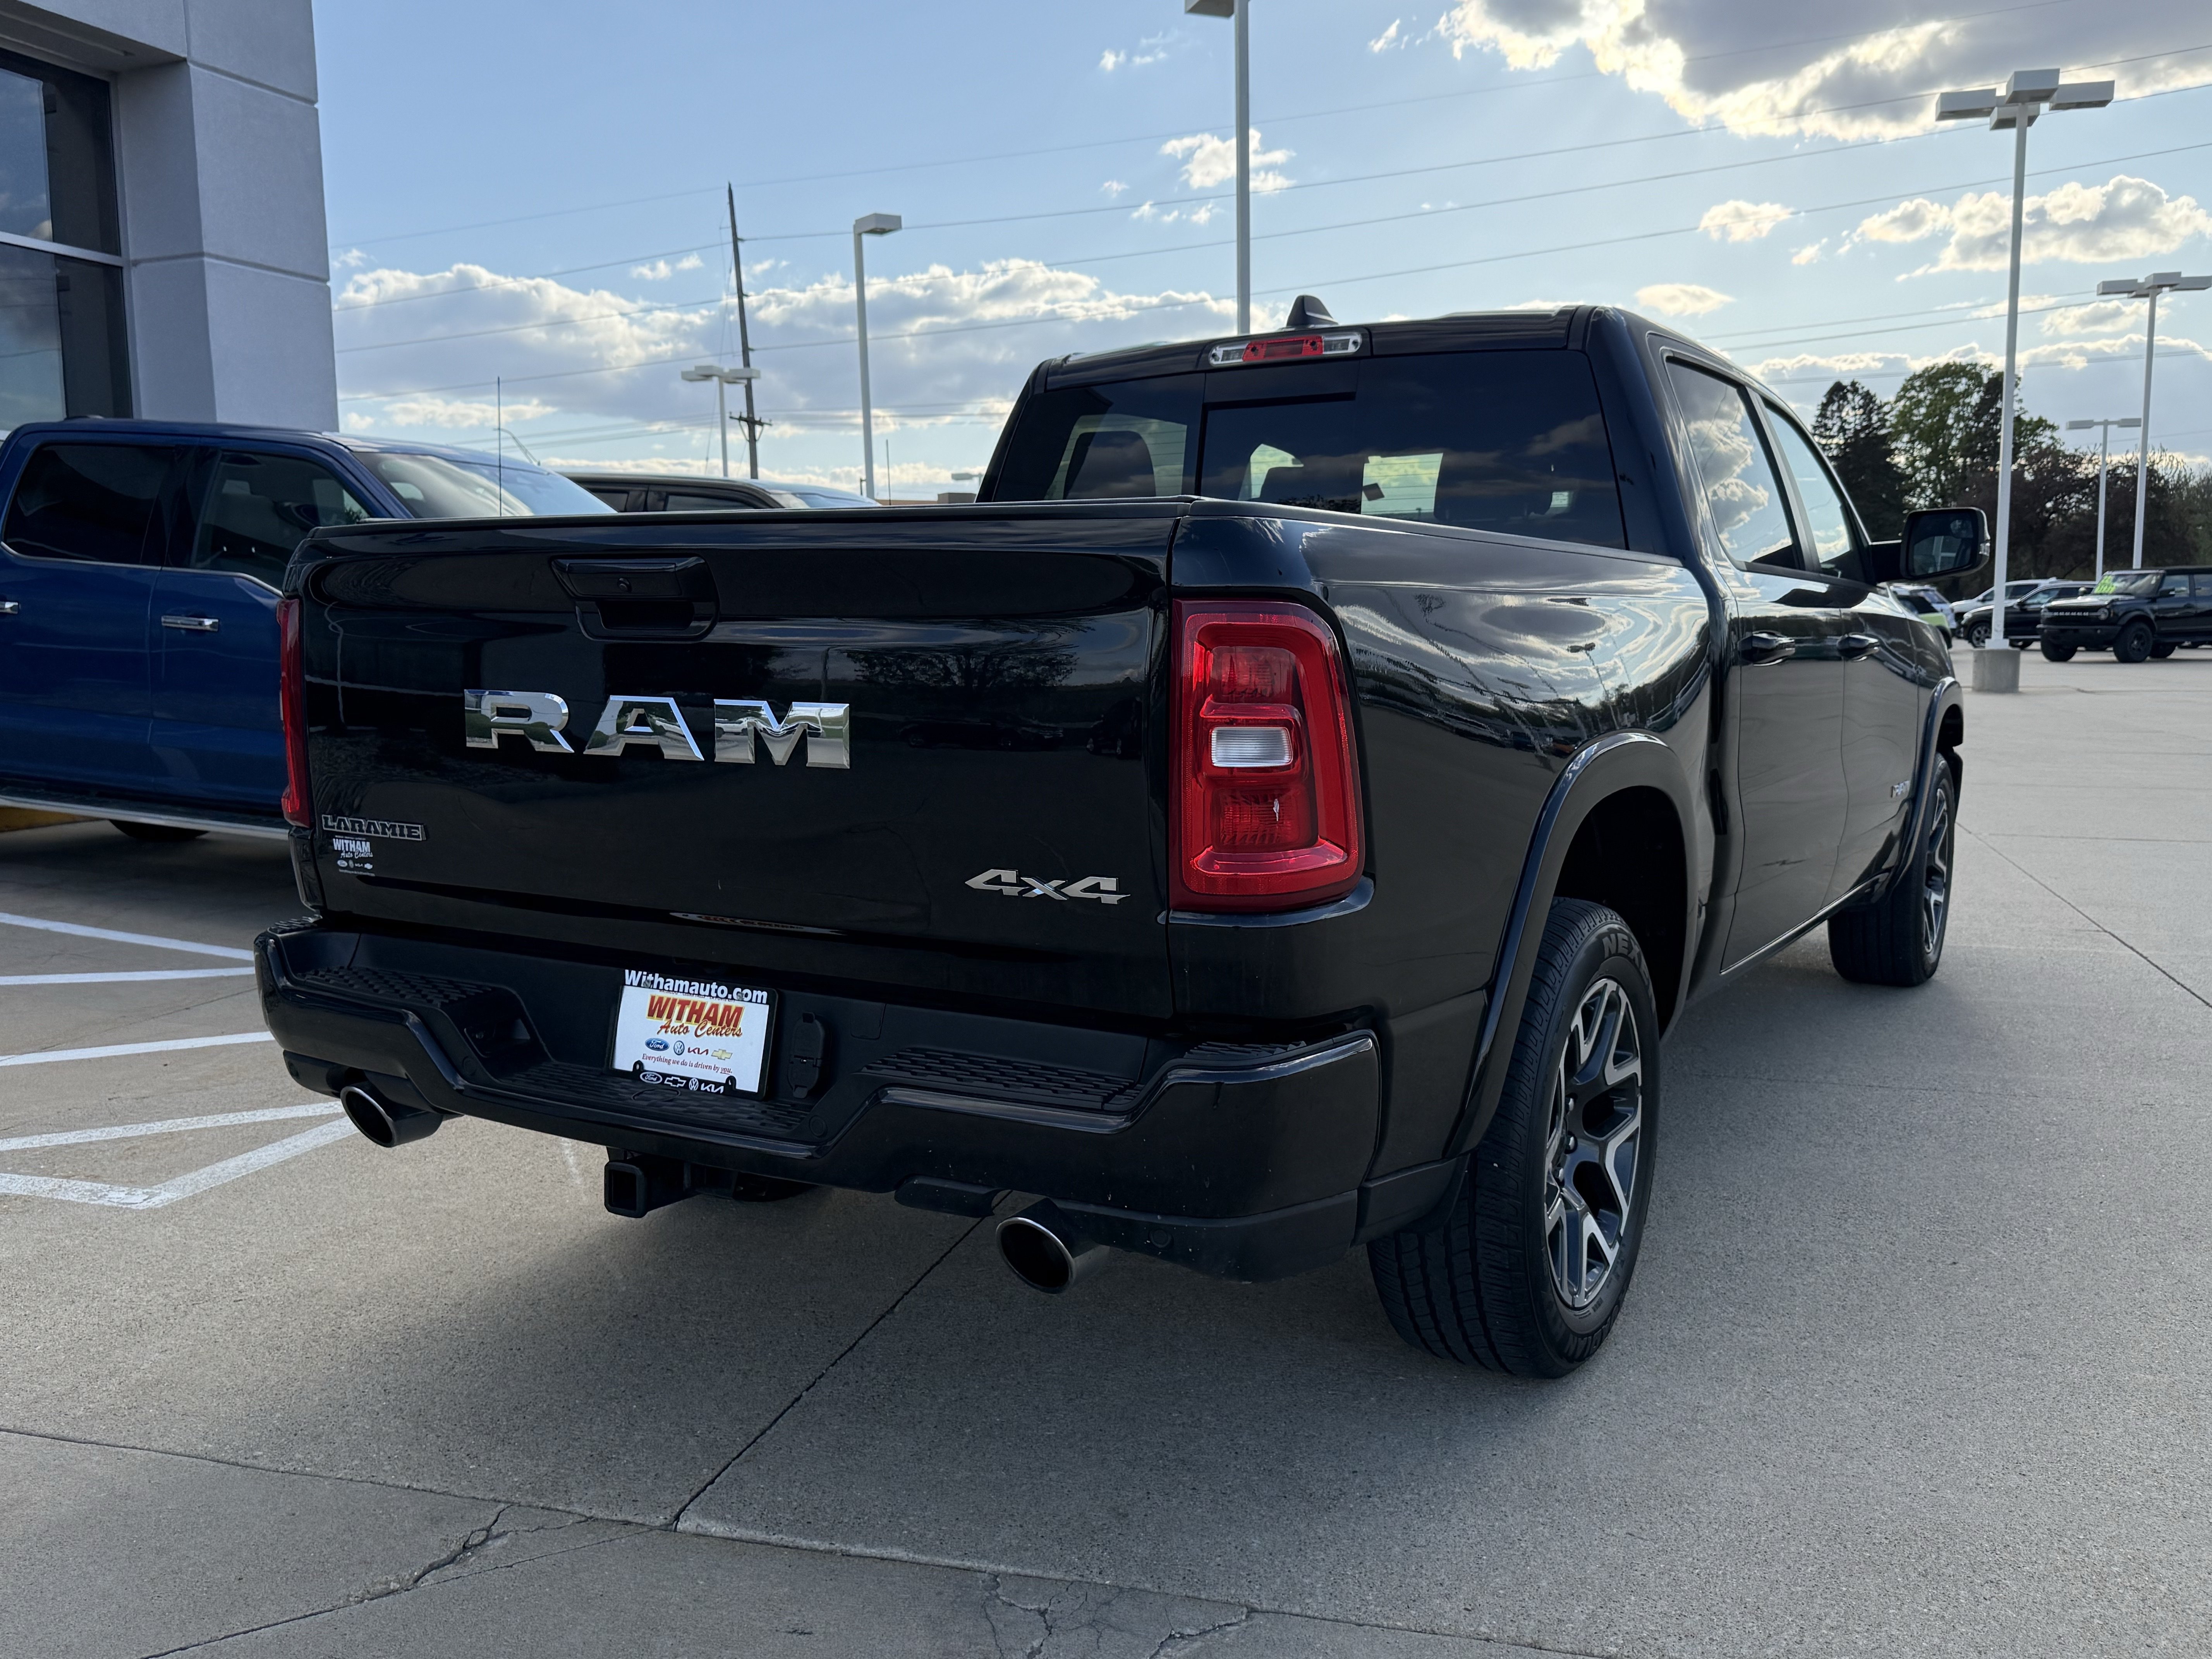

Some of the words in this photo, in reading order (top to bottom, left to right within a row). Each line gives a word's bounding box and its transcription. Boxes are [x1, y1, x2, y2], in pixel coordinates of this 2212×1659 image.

[464, 689, 850, 768] RAM
[322, 814, 424, 841] LARAMIE
[333, 838, 371, 852] WITHAM
[625, 970, 768, 1004] Withamauto.com
[647, 994, 744, 1028] WITHAM
[657, 1020, 689, 1035] Auto
[694, 1020, 743, 1037] Centers
[648, 1039, 666, 1050] Ford
[642, 1053, 672, 1065] Everything
[694, 1061, 712, 1070] driven
[713, 1064, 720, 1072] by
